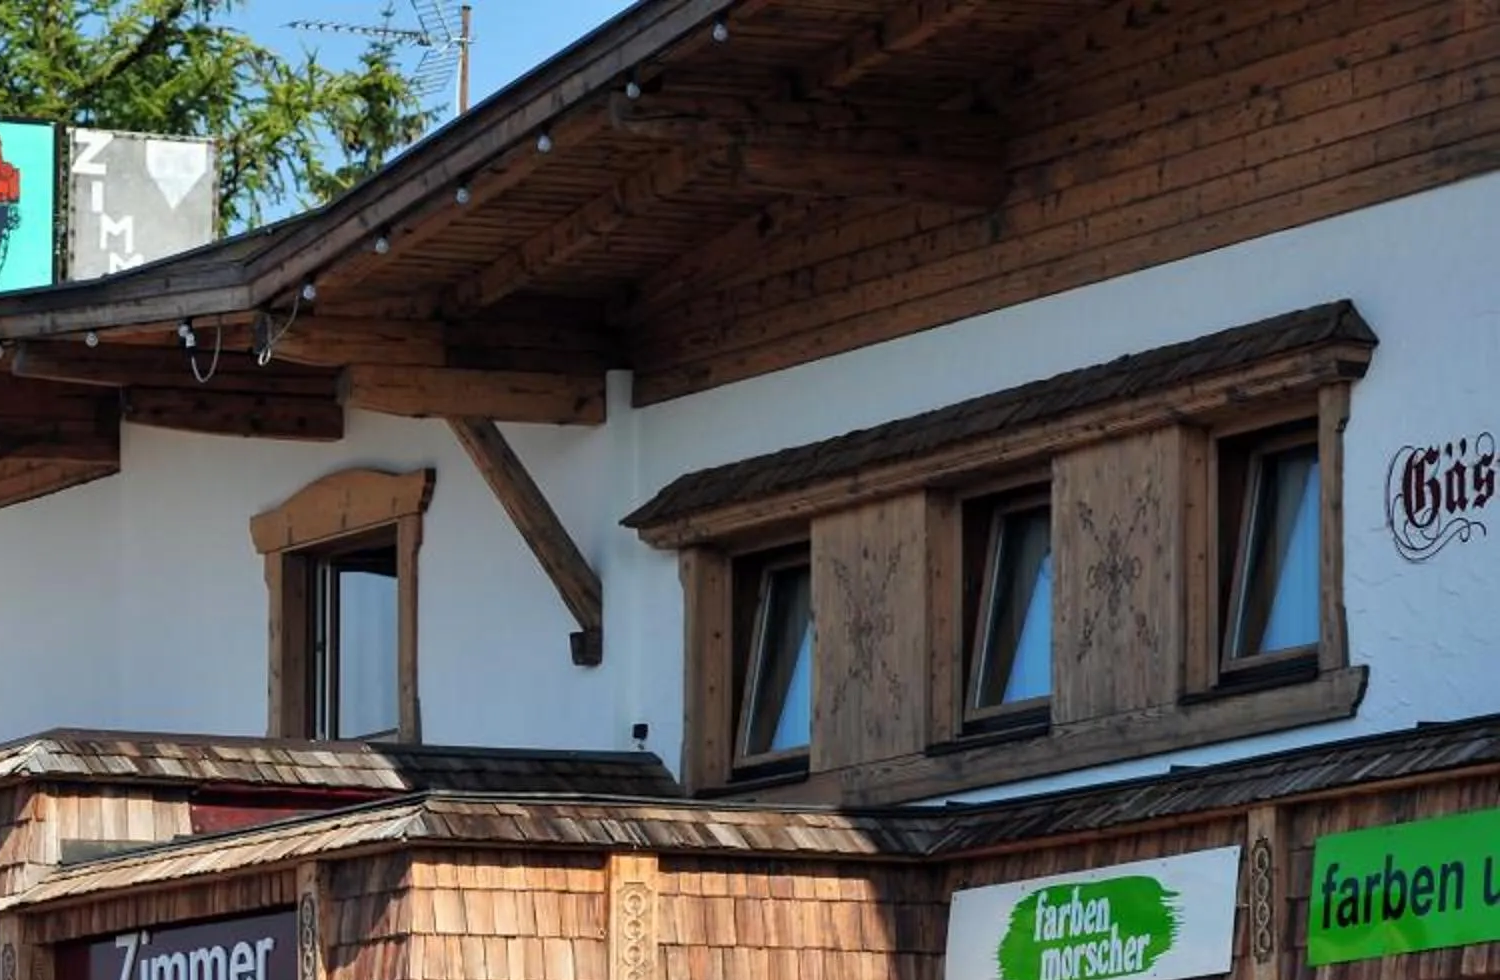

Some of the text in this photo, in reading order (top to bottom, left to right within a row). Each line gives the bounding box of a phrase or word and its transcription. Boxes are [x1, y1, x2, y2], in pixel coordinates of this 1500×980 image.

[1387, 432, 1500, 550] Gäs
[1033, 886, 1110, 942] farben
[1321, 854, 1464, 929] farben
